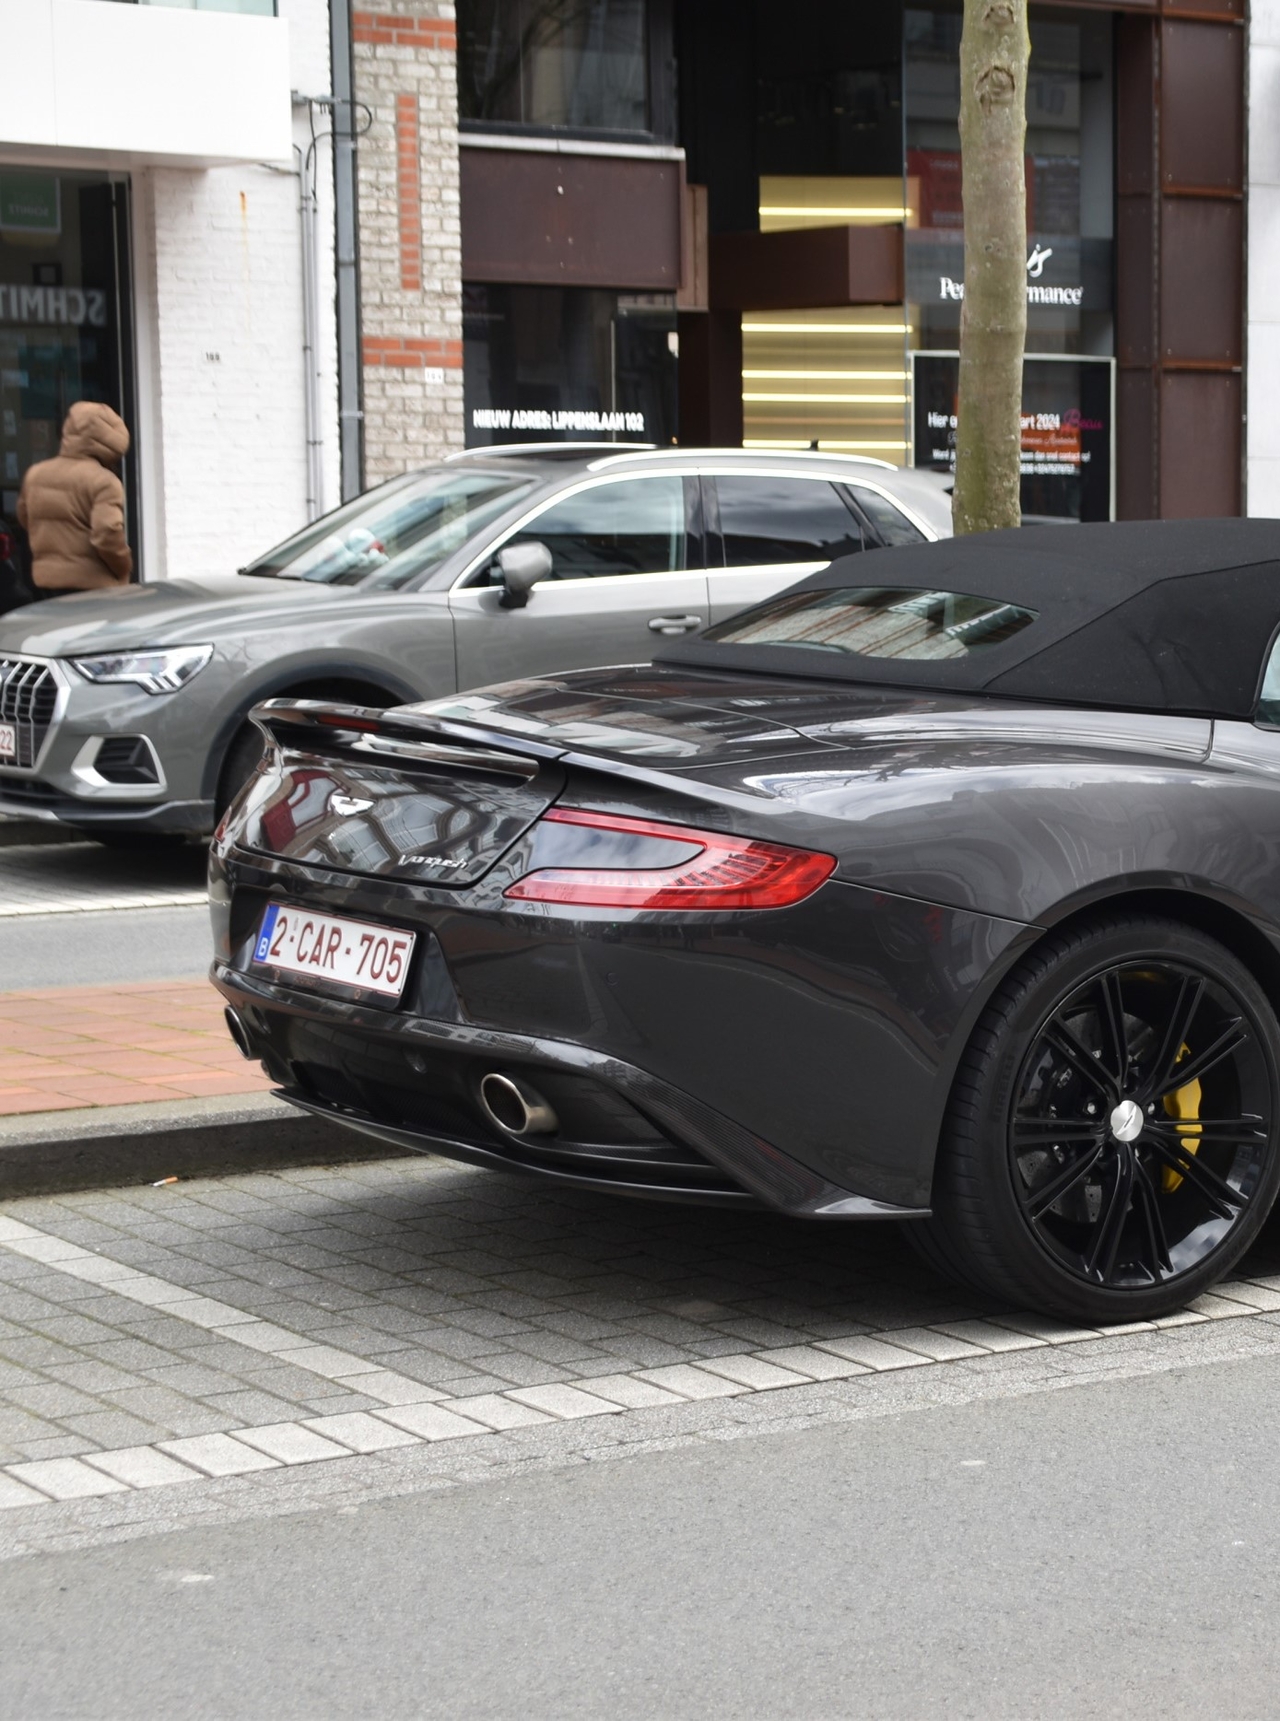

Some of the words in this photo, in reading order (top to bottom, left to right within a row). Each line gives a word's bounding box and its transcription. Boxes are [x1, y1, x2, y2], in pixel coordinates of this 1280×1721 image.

[473, 409, 511, 429] NIEUW
[512, 410, 551, 430] ADRES:
[552, 411, 625, 431] LIPPENSLAAN
[625, 412, 645, 431] 102
[928, 411, 949, 429] Hier
[1020, 414, 1036, 430] art
[1036, 412, 1060, 431] 2024
[398, 854, 469, 869] Vanquish
[258, 937, 270, 958] B
